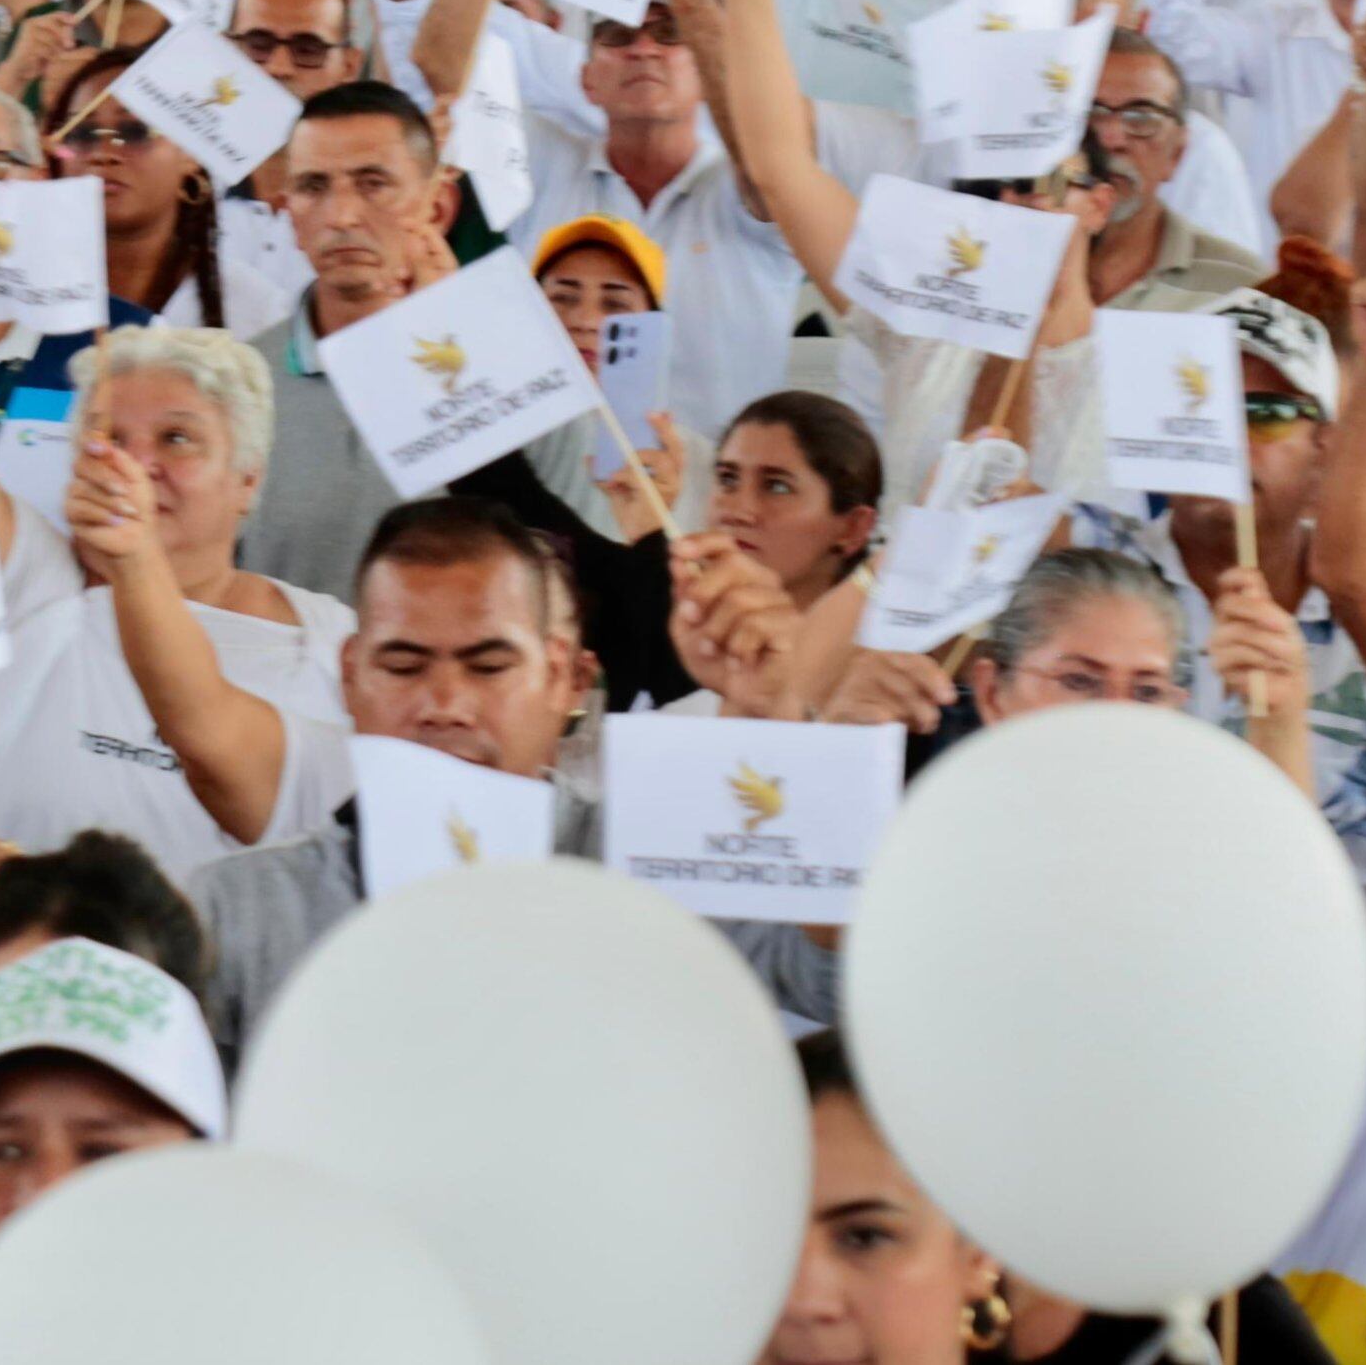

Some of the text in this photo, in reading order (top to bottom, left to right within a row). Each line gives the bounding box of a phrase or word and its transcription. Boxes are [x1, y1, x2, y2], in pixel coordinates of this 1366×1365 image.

[704, 834, 795, 860] NORTE
[788, 865, 825, 887] DE
[830, 866, 863, 888] PA
